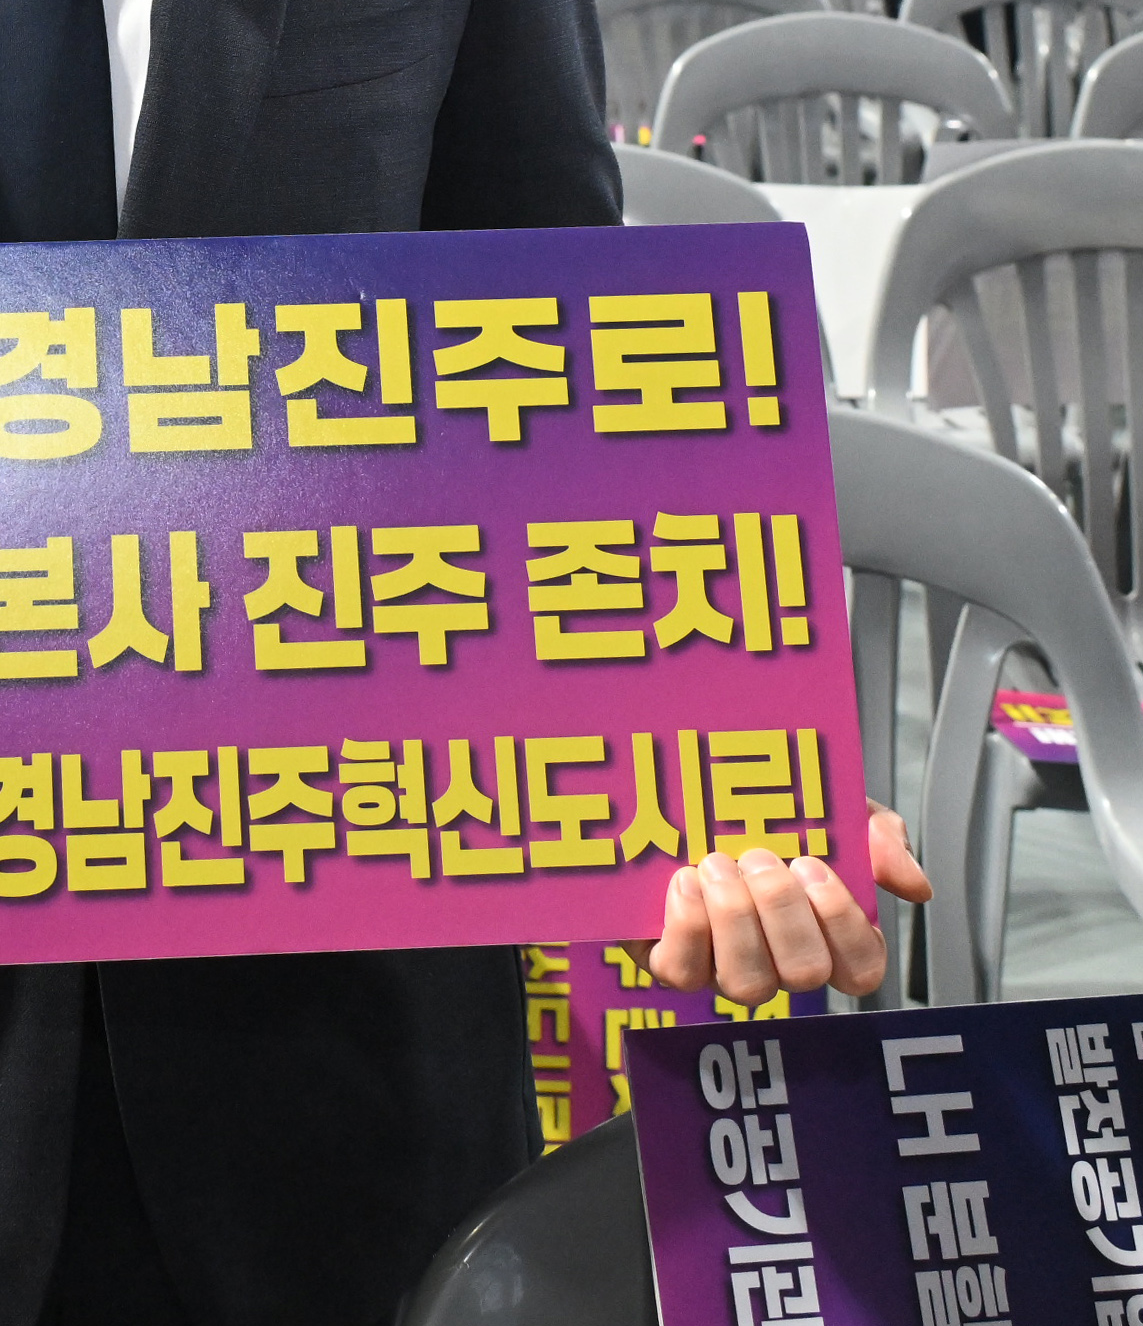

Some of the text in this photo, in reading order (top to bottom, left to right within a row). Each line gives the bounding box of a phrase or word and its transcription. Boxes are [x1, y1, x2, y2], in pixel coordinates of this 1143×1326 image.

[243, 524, 489, 671] 진주
[526, 510, 810, 661] 존치!
[881, 1034, 981, 1157] LH
